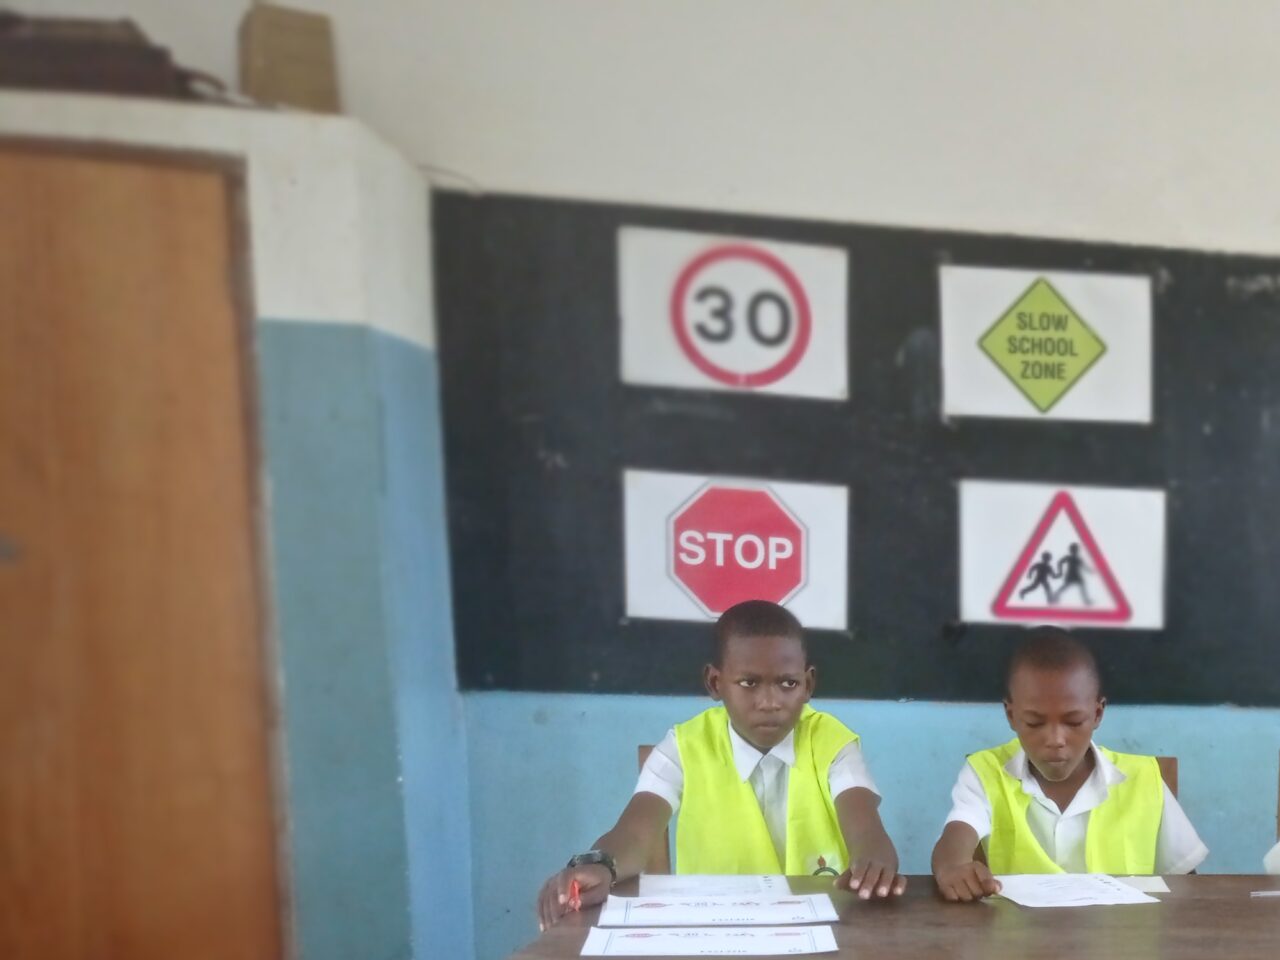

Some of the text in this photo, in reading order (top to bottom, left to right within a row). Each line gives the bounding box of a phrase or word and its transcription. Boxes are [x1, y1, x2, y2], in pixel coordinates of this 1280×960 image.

[695, 286, 791, 347] 30
[1016, 311, 1068, 331] SLOW
[1007, 335, 1079, 357] SCHOOL
[1020, 360, 1066, 380] ZONE
[679, 530, 794, 570] STOP
